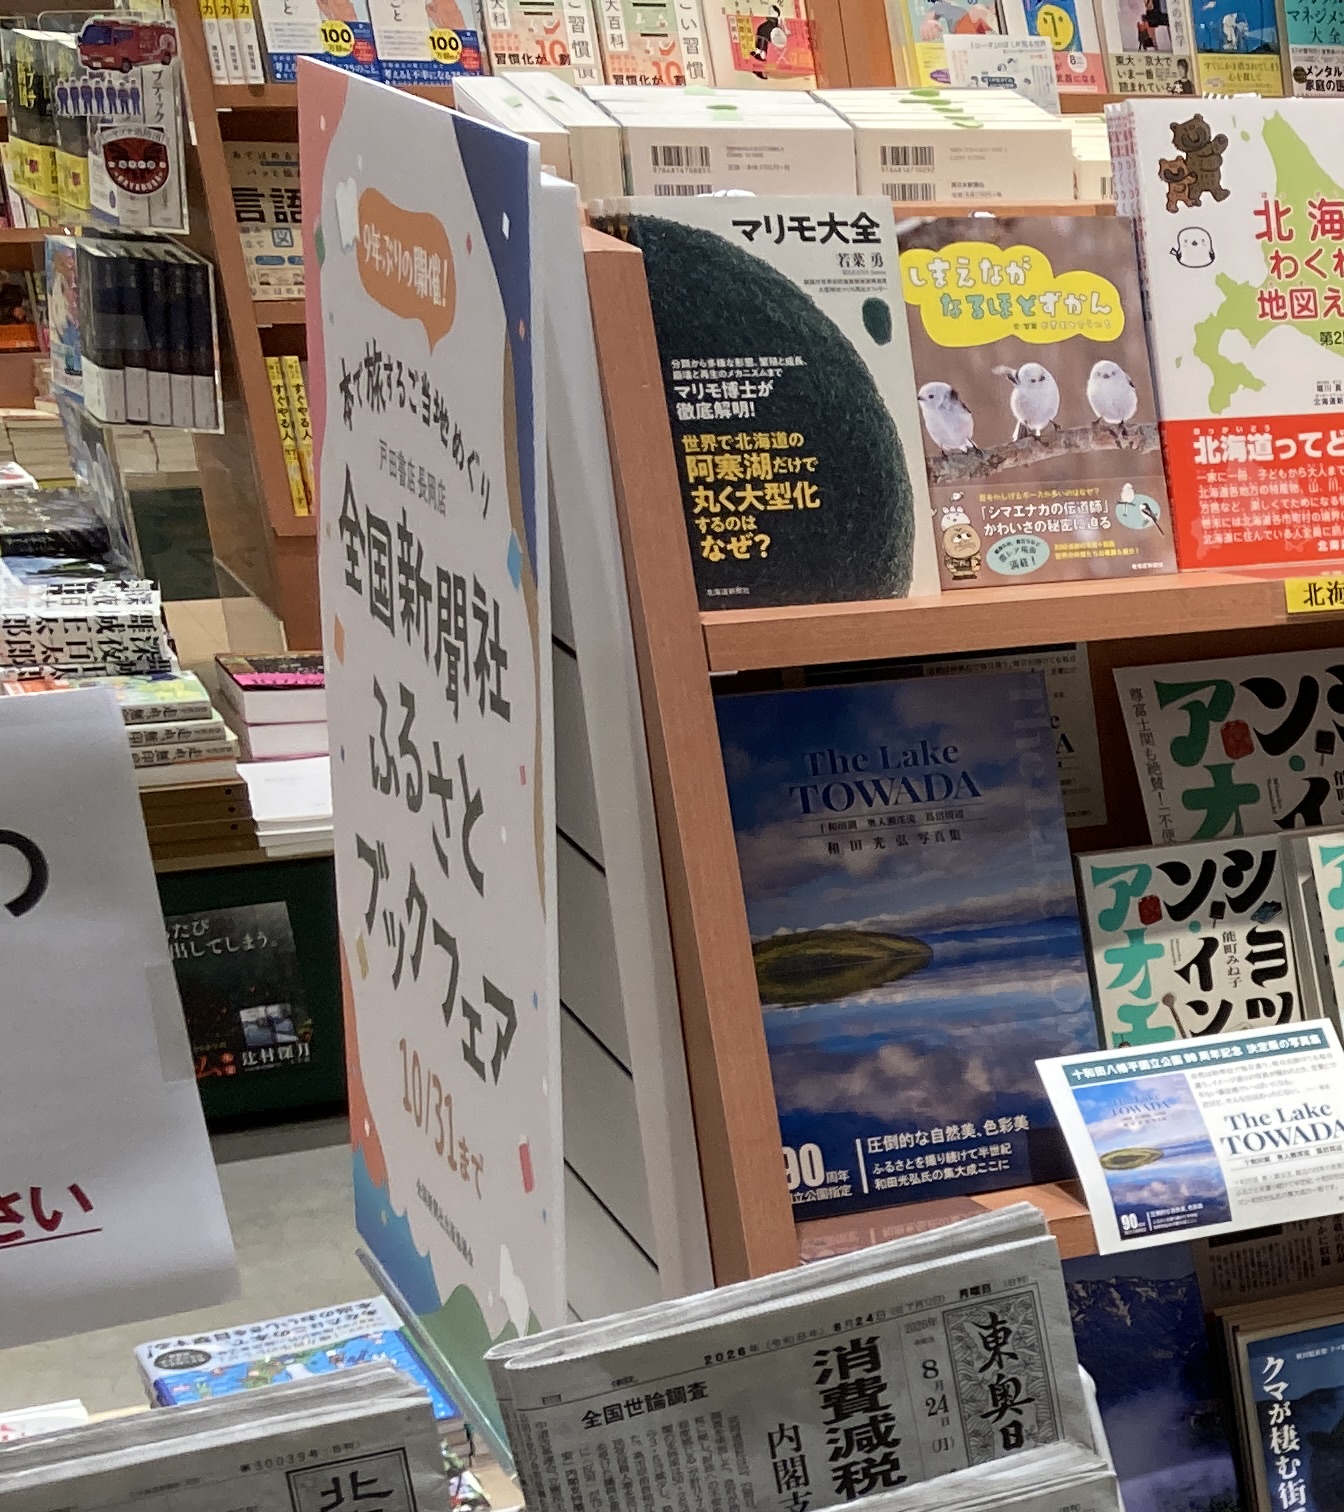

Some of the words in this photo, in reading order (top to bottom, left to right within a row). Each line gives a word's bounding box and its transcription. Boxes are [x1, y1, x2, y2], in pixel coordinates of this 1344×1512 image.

[731, 215, 882, 245] マリモ大全
[361, 224, 449, 309] 9年ぶりの開催!
[836, 252, 864, 269] 若菜
[870, 252, 884, 268] 勇
[908, 257, 1032, 288] しまえなが
[940, 290, 1112, 319] なるほどずかん
[674, 380, 773, 399] マリモ博士が
[338, 338, 492, 520] 本で旅するご当地めぐり
[676, 401, 755, 420] 徹底解明!
[682, 432, 805, 452] 世界で北海道の
[686, 453, 818, 483] 阿寒湖だけで
[691, 481, 821, 514] 丸く大型化
[695, 515, 756, 533] するのは
[701, 533, 771, 562] なぜ?
[339, 470, 511, 723] 全国新聞社
[803, 746, 869, 778] The
[880, 739, 961, 769] Lake
[369, 675, 484, 898] ふるさと
[788, 770, 982, 816] TOWADA
[355, 833, 518, 1086] ブックフェア
[1222, 930, 1242, 989] 能町みね子
[399, 1038, 485, 1200] 10/31まで
[866, 1114, 1030, 1155] 圧倒的な自然美、色彩美
[1225, 1112, 1276, 1132] The
[1280, 1103, 1333, 1123] Lake
[971, 1311, 1036, 1453] 東奥日
[580, 1380, 709, 1430] 全国世論調査
[811, 1335, 908, 1500] 消費減税
